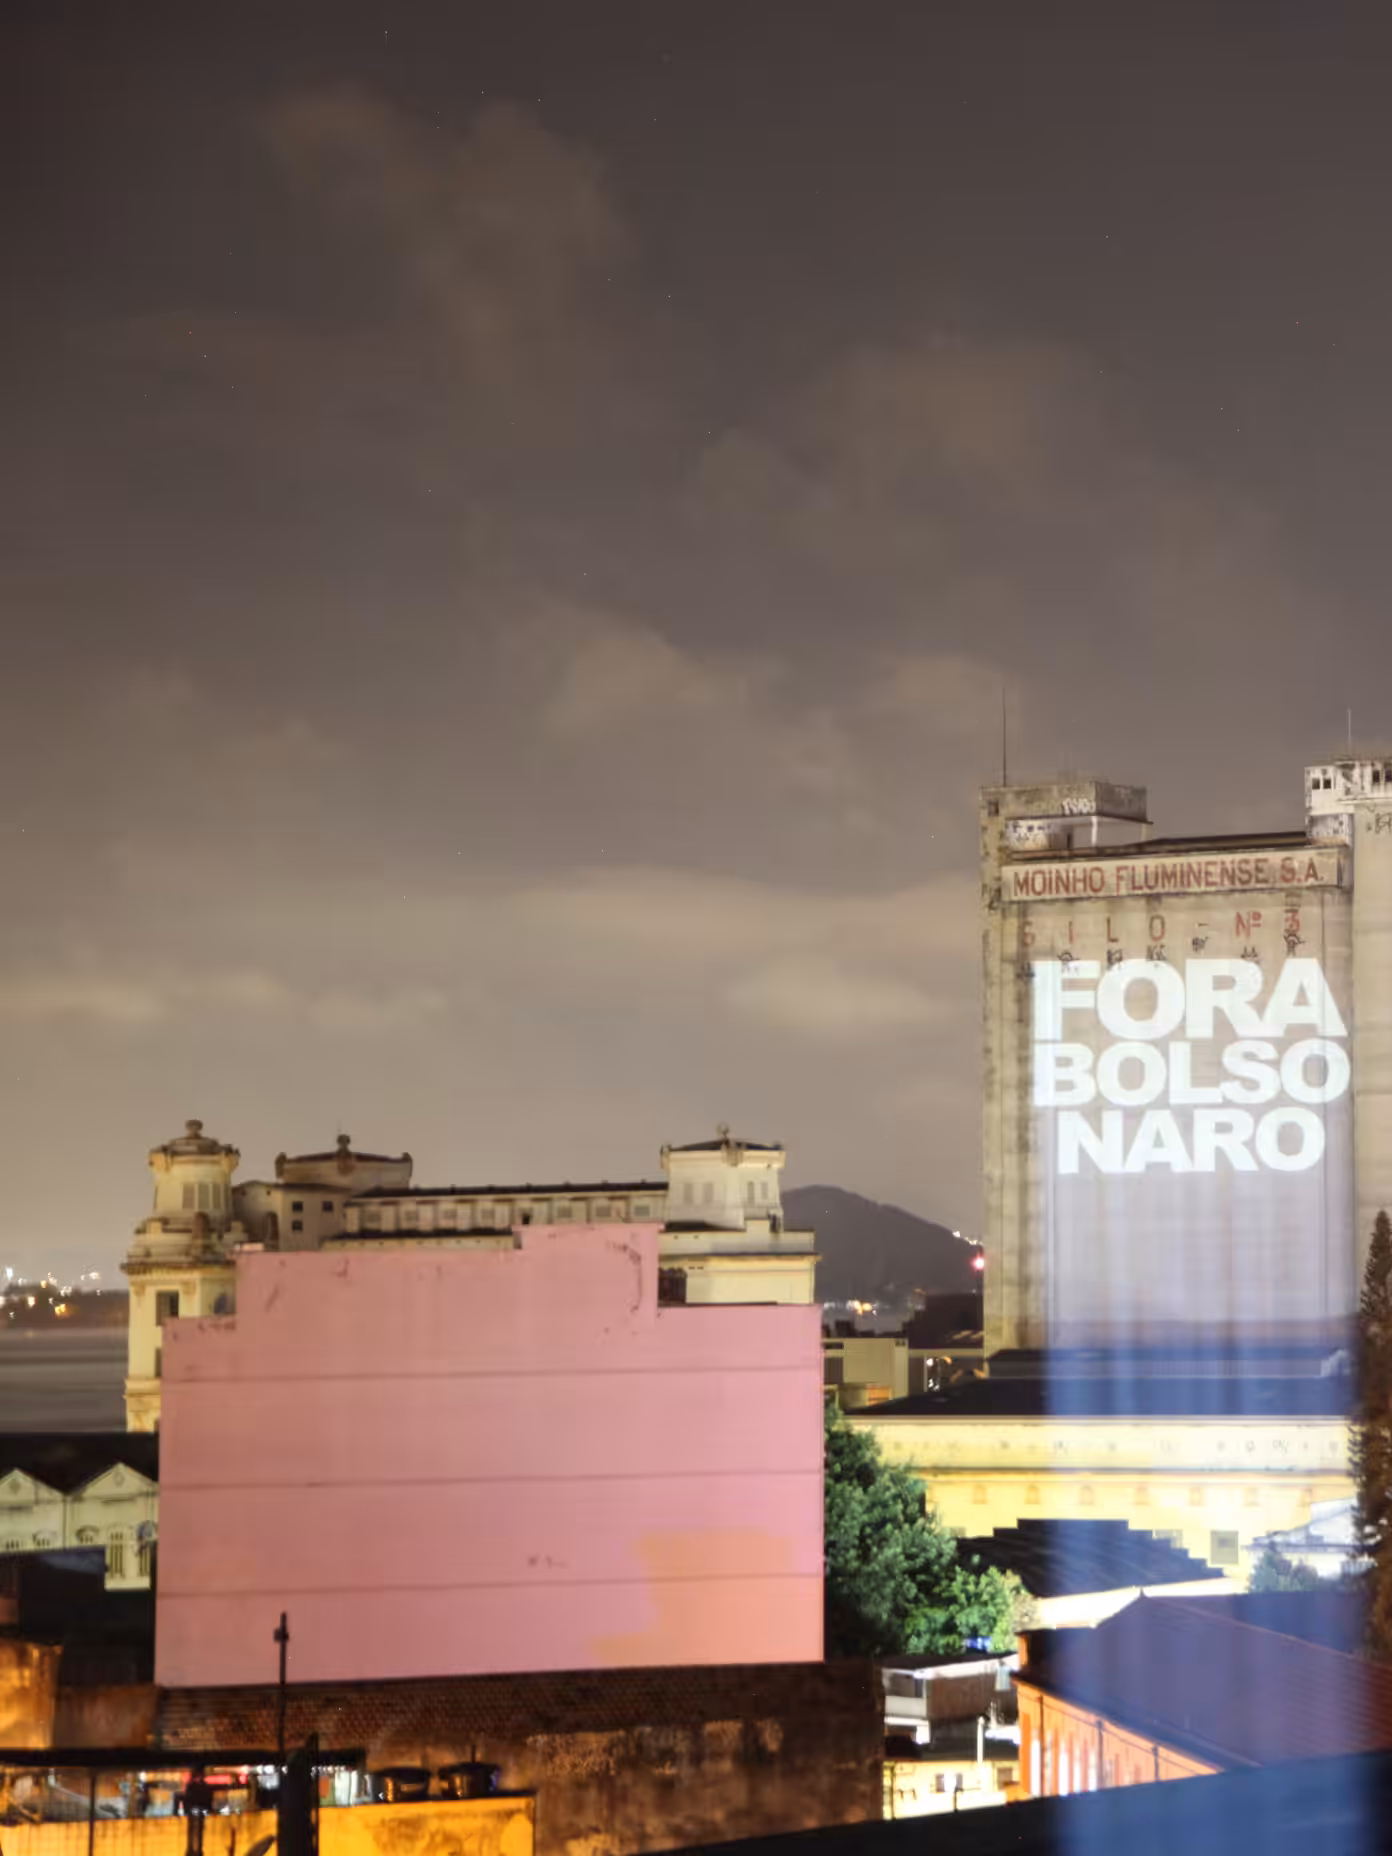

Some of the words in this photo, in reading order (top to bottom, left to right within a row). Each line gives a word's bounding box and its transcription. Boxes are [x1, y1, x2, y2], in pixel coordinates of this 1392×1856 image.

[1014, 867, 1105, 897] MOINHO
[1116, 857, 1269, 894] FLUMINENSE
[1280, 856, 1325, 884] S.A.
[1033, 958, 1348, 1040] FORA
[1033, 1038, 1351, 1107] BOLSO
[1057, 1106, 1326, 1175] NARO
